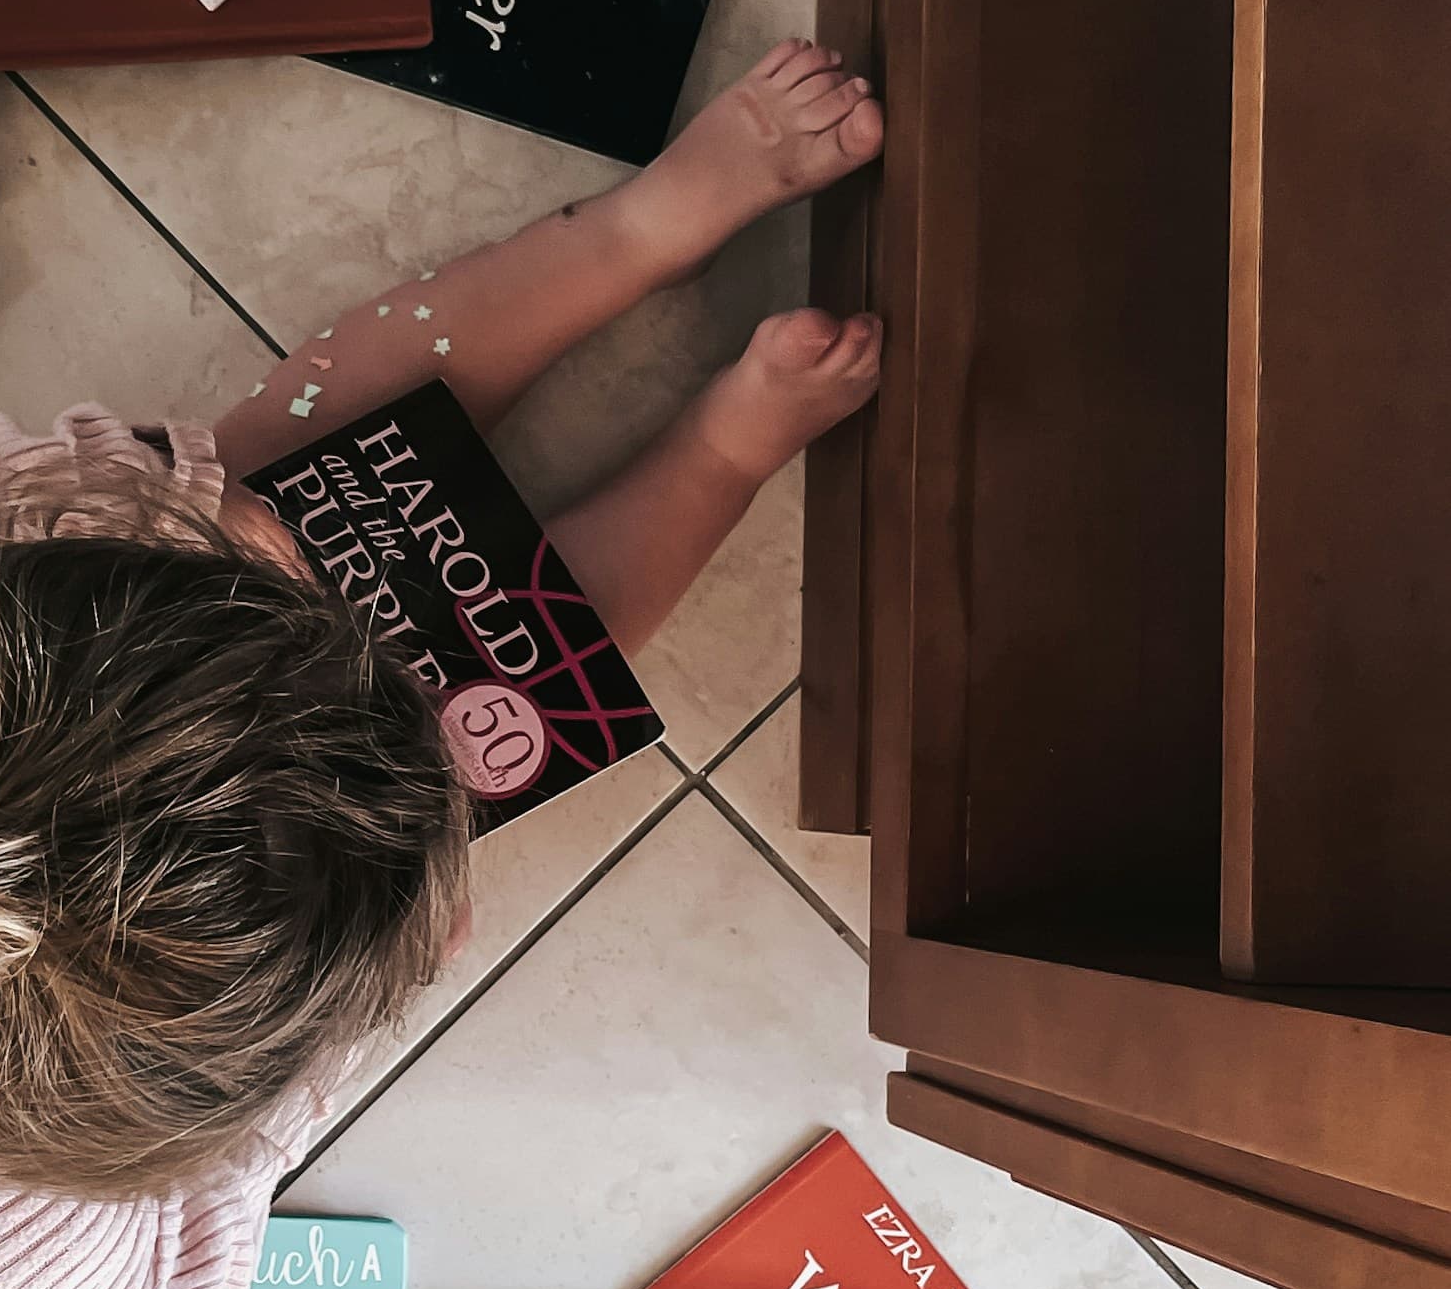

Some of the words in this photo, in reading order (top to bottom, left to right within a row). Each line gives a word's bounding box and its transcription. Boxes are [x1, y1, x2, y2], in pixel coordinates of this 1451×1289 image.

[321, 453, 387, 511] and
[362, 515, 406, 562] the
[354, 419, 539, 676] HAROLD
[252, 1225, 354, 1287] uch
[361, 1243, 382, 1281] A
